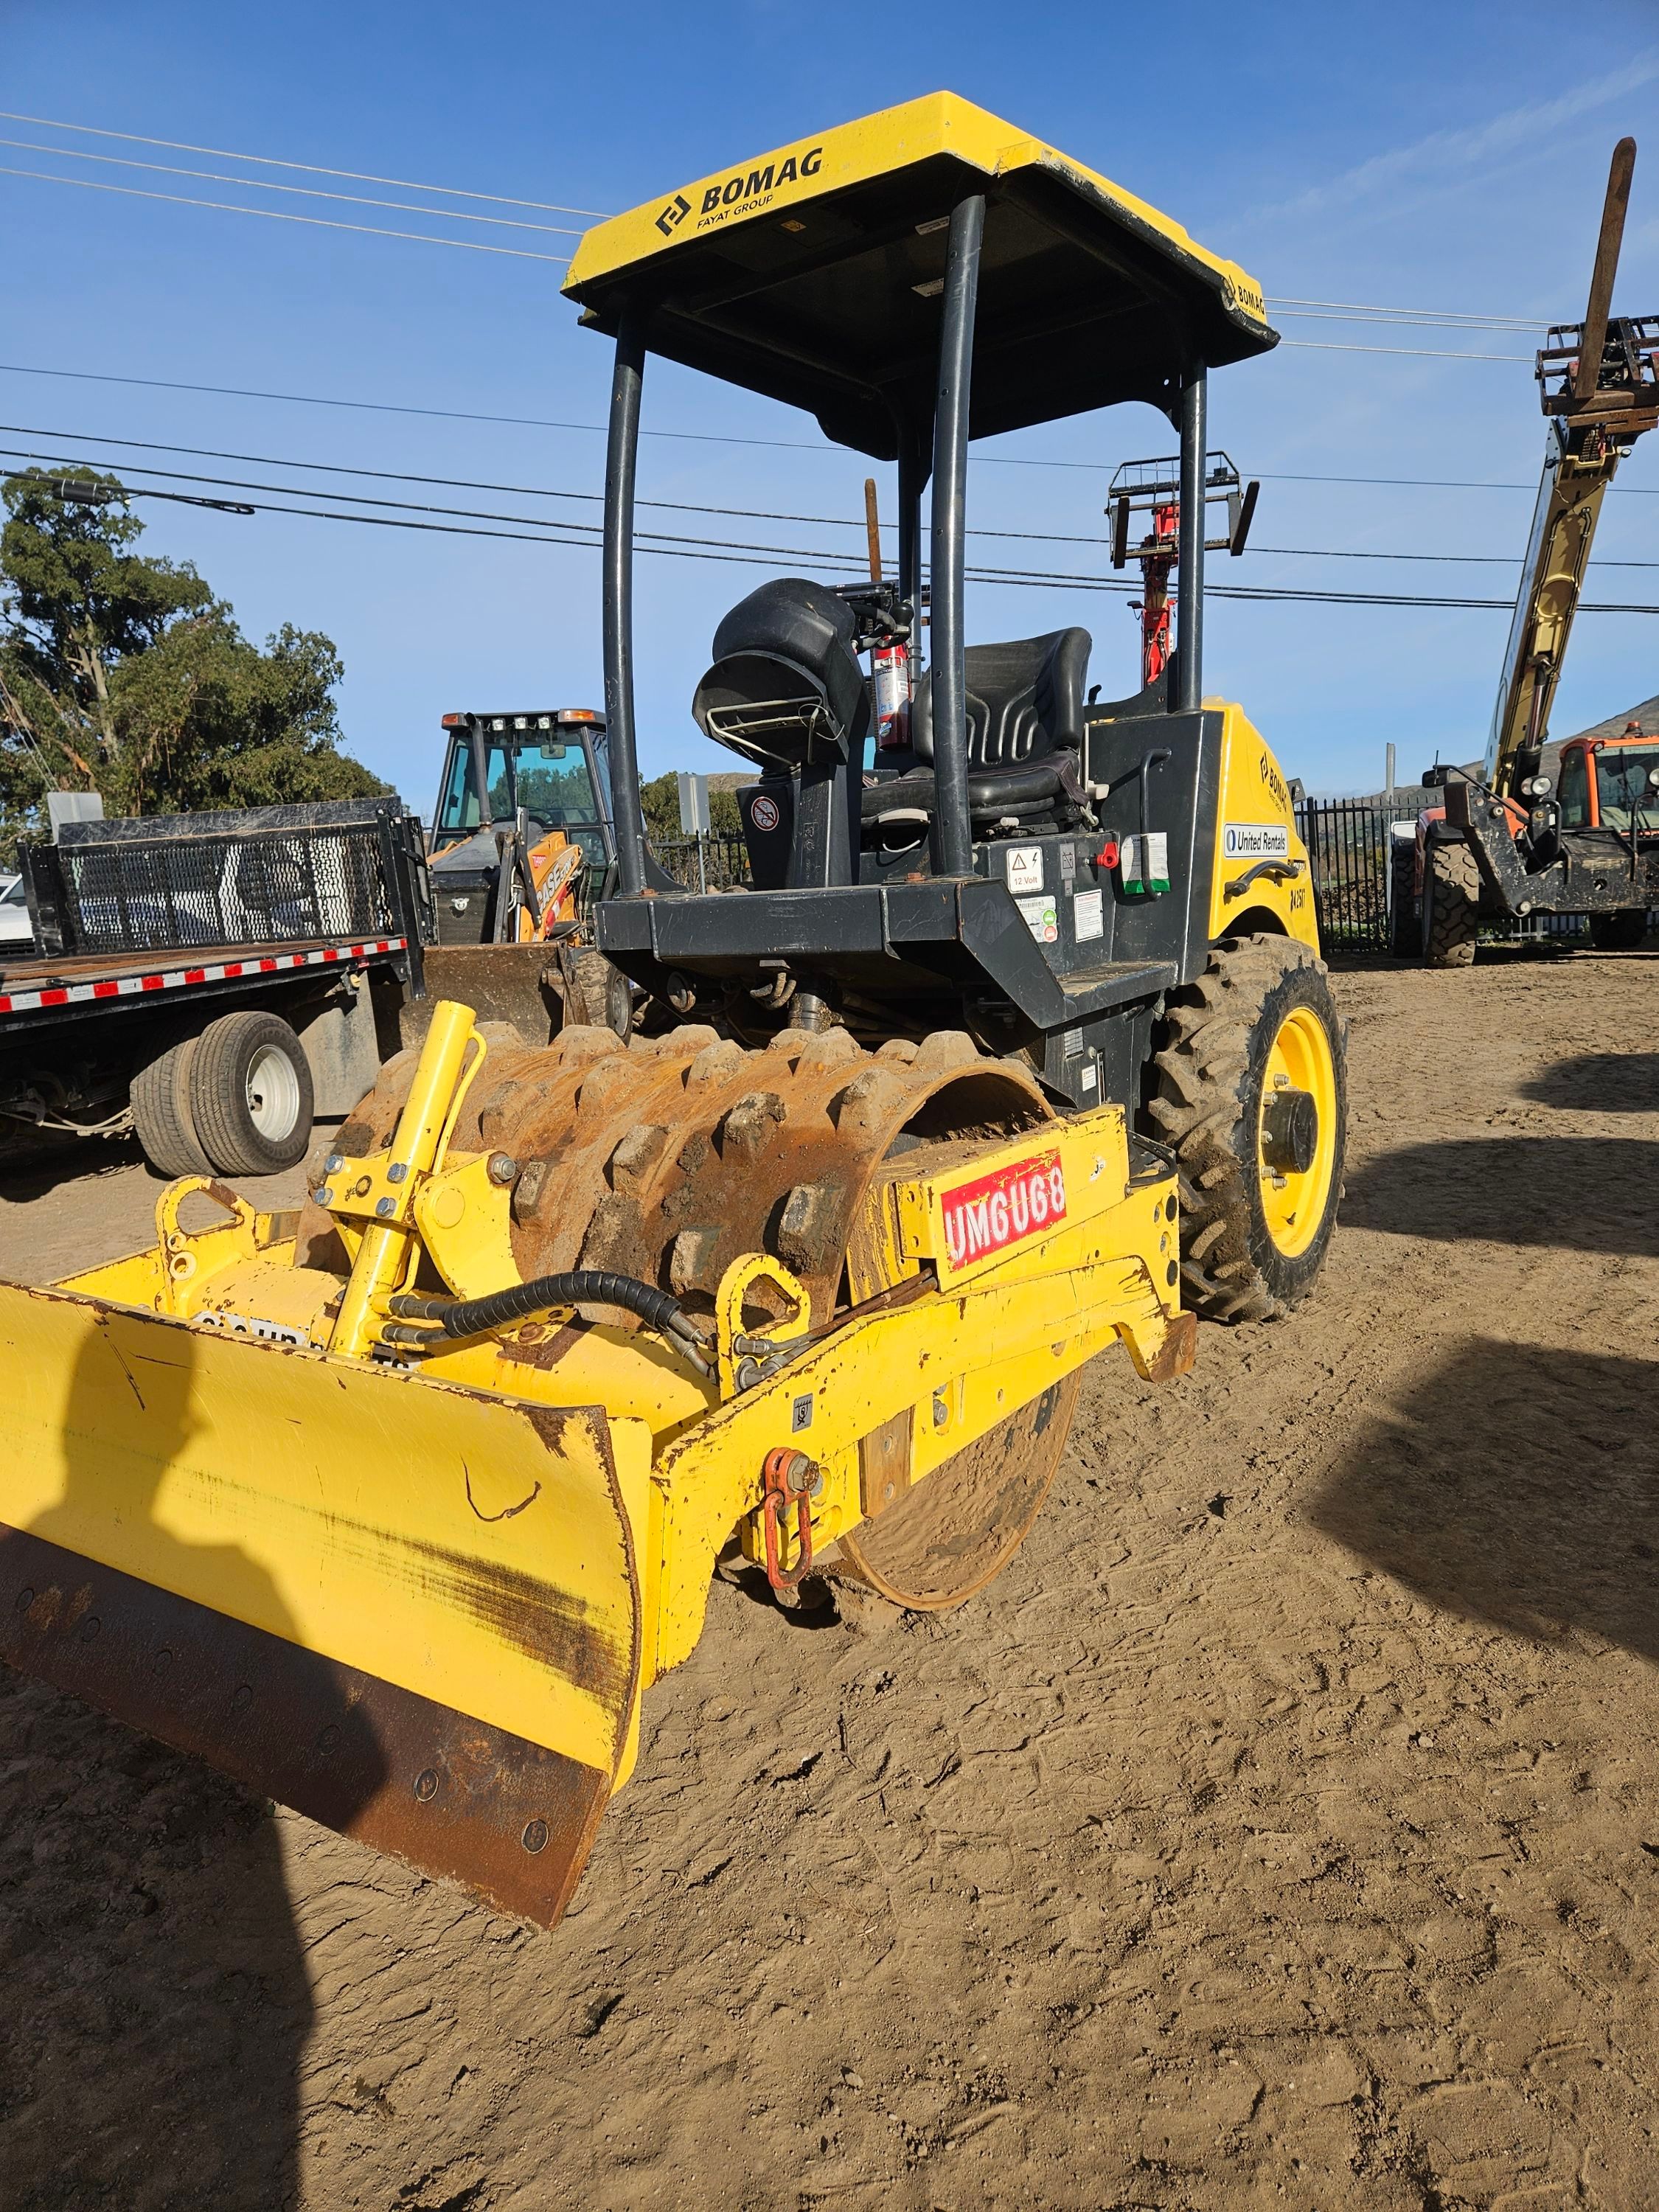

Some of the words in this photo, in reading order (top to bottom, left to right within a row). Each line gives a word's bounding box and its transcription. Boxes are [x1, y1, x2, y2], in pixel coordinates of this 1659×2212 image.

[700, 147, 824, 215] BOMAG
[696, 209, 731, 230] FAYAT
[733, 194, 774, 216] GROUP
[1237, 285, 1265, 316] BOMAG
[1237, 830, 1262, 852] United
[1262, 831, 1286, 852] Rentals
[536, 861, 562, 916] CASE
[1014, 877, 1023, 886] 12
[1024, 876, 1038, 885] Volt
